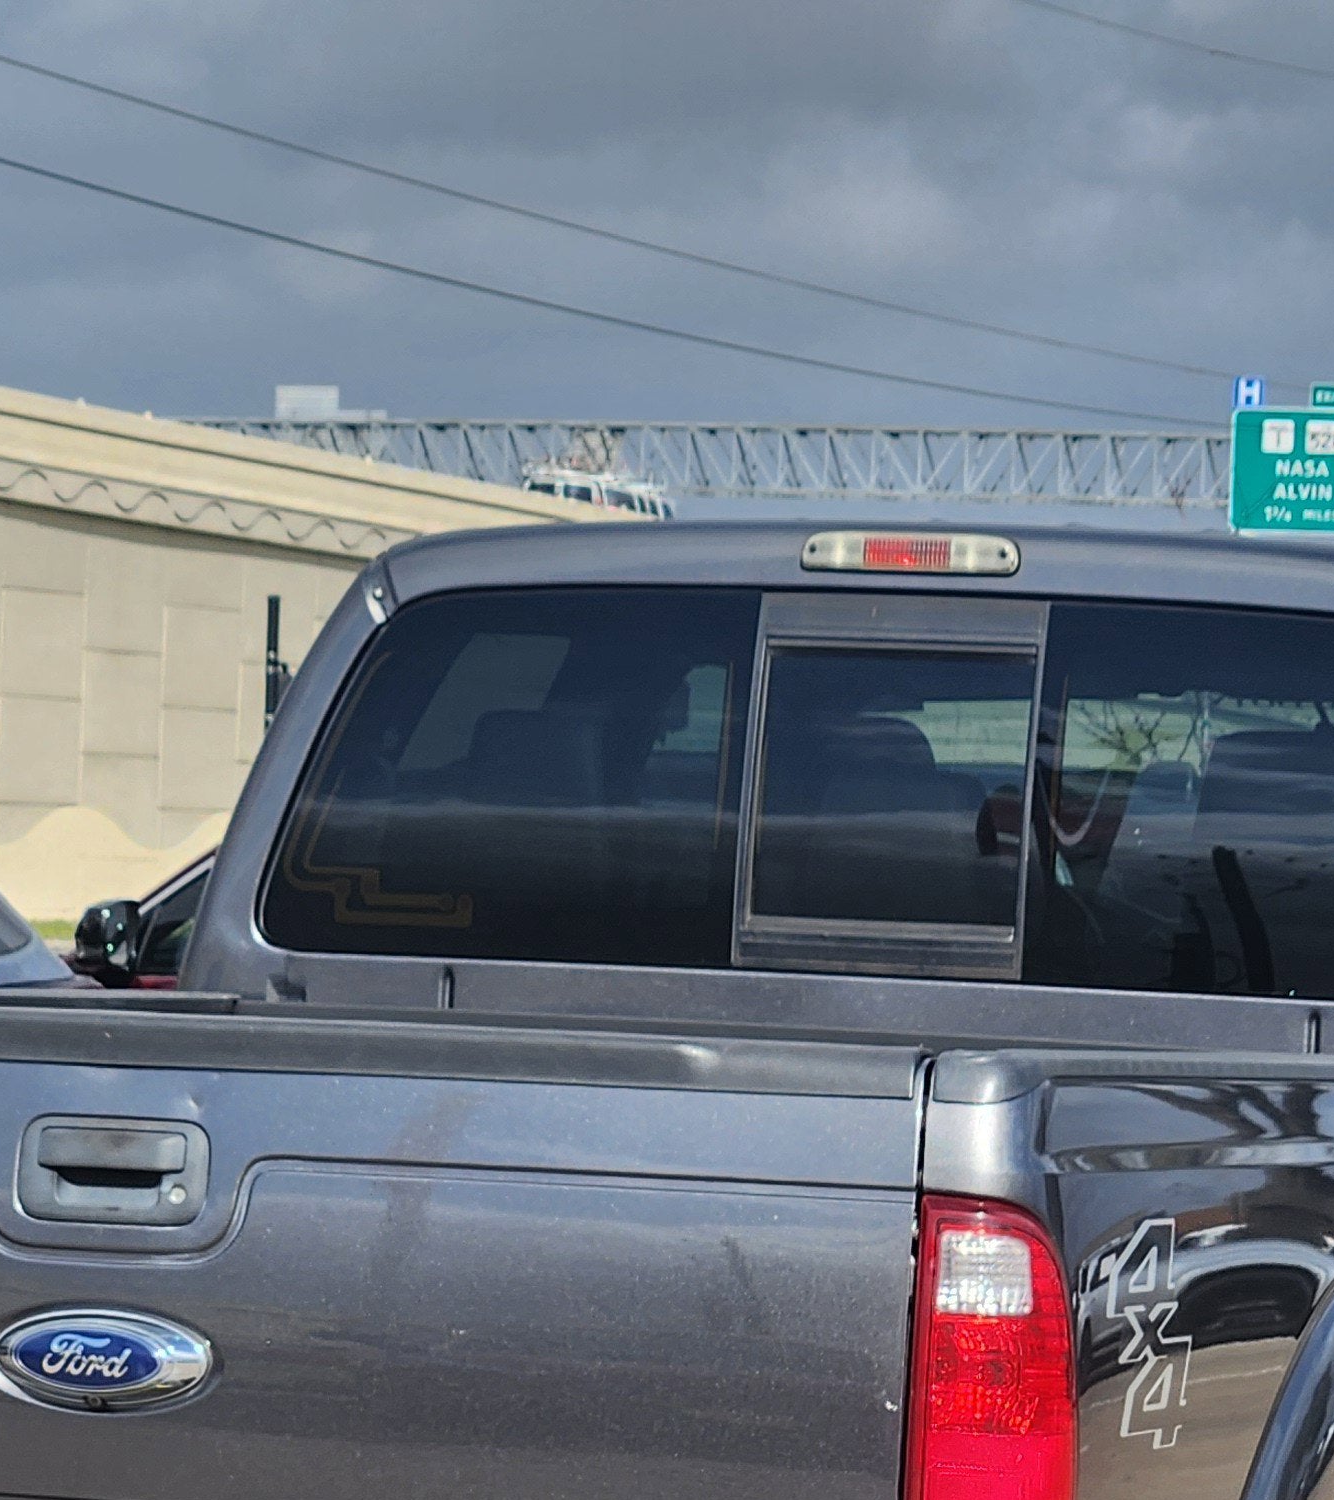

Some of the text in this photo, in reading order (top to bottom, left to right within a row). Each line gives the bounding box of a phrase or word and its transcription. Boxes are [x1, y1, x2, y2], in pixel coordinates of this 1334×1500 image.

[1274, 459, 1330, 479] NASA
[1272, 482, 1334, 501] ALVIN
[41, 1332, 133, 1379] Ford
